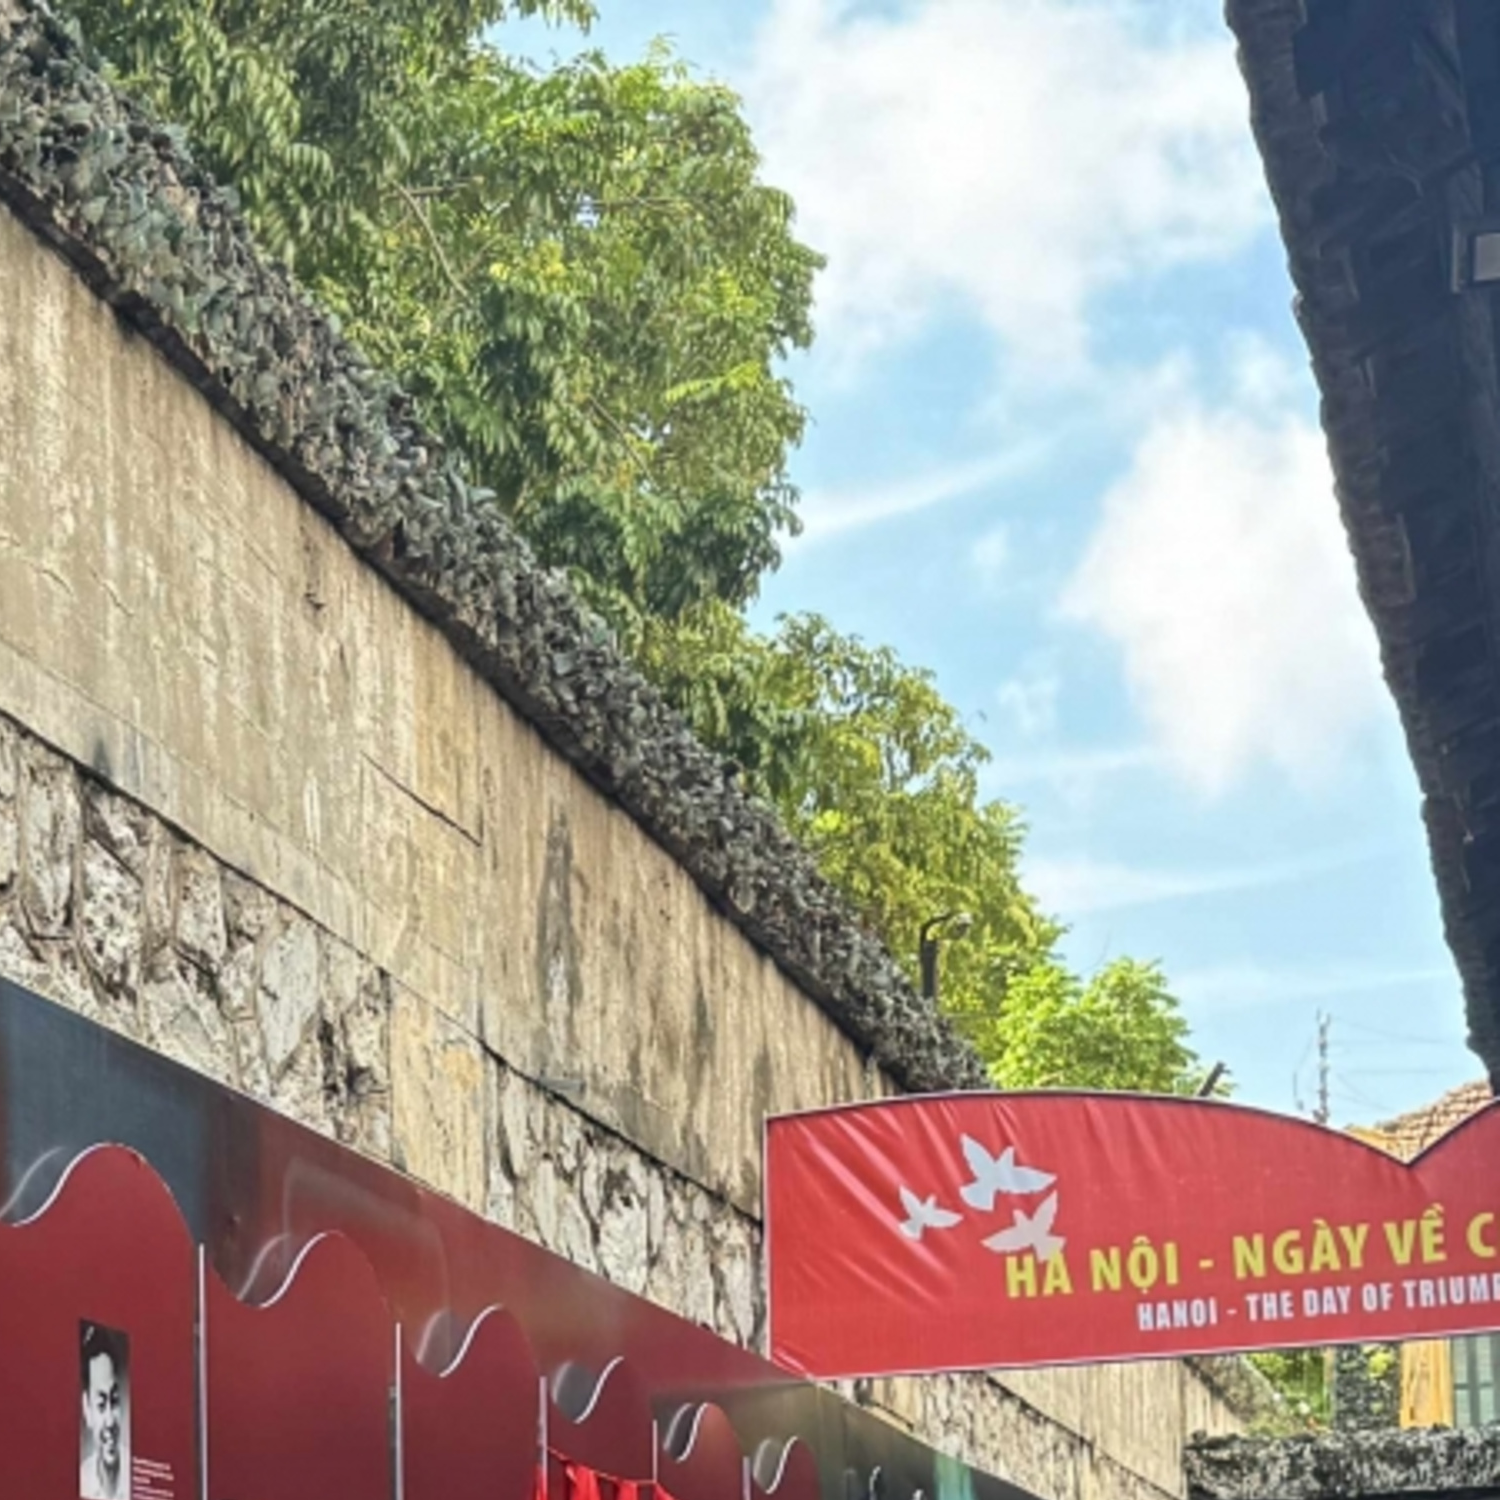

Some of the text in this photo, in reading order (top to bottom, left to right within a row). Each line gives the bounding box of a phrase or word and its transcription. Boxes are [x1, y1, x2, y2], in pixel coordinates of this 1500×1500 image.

[1089, 1235, 1179, 1294] NỘI
[1232, 1218, 1370, 1279] NGÀY
[1383, 1202, 1447, 1265] VỀ
[1137, 1298, 1217, 1331] HANOI
[1245, 1291, 1294, 1322] THE
[1303, 1285, 1352, 1318] DAY
[1362, 1282, 1394, 1312] OF
